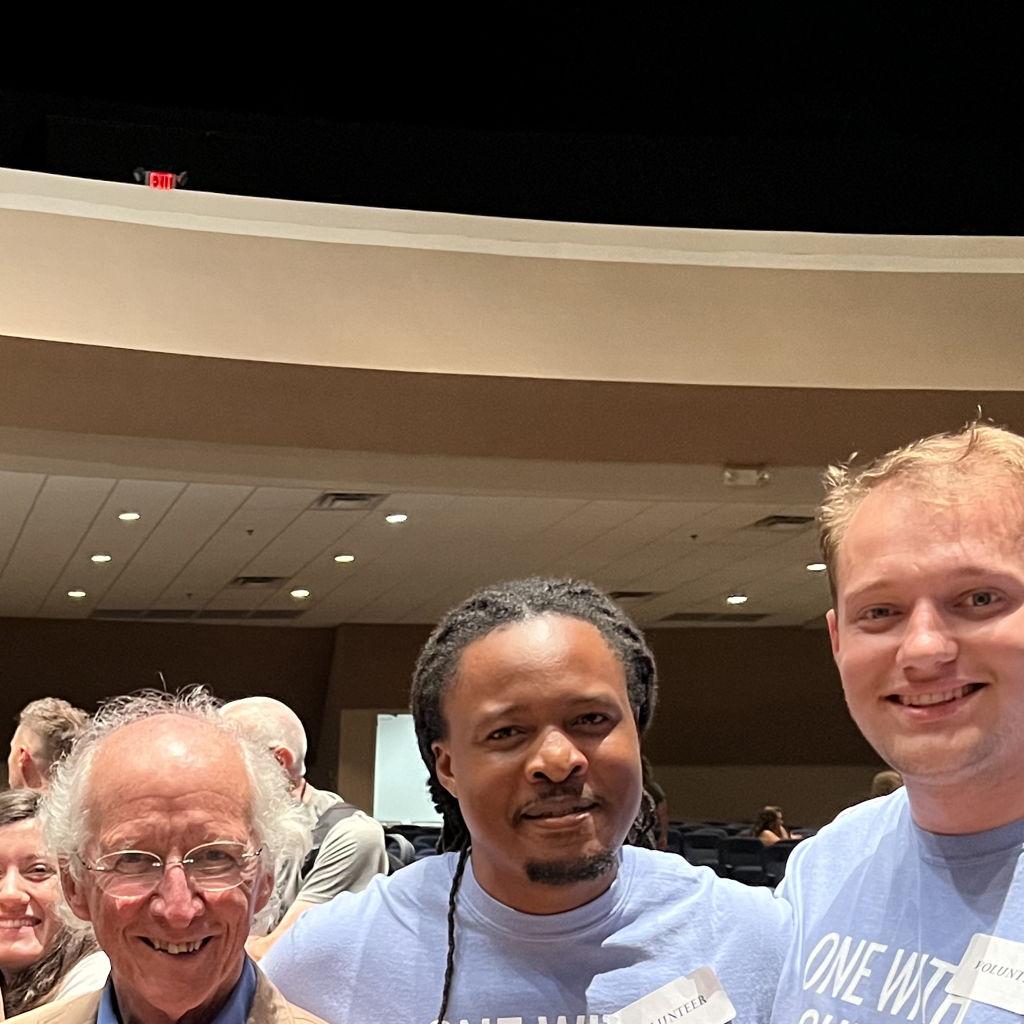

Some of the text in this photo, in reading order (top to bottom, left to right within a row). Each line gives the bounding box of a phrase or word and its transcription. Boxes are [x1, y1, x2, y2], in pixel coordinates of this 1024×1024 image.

[149, 172, 173, 190] EXIT
[803, 932, 888, 1006] ONE
[974, 960, 1024, 983] VOLUNT
